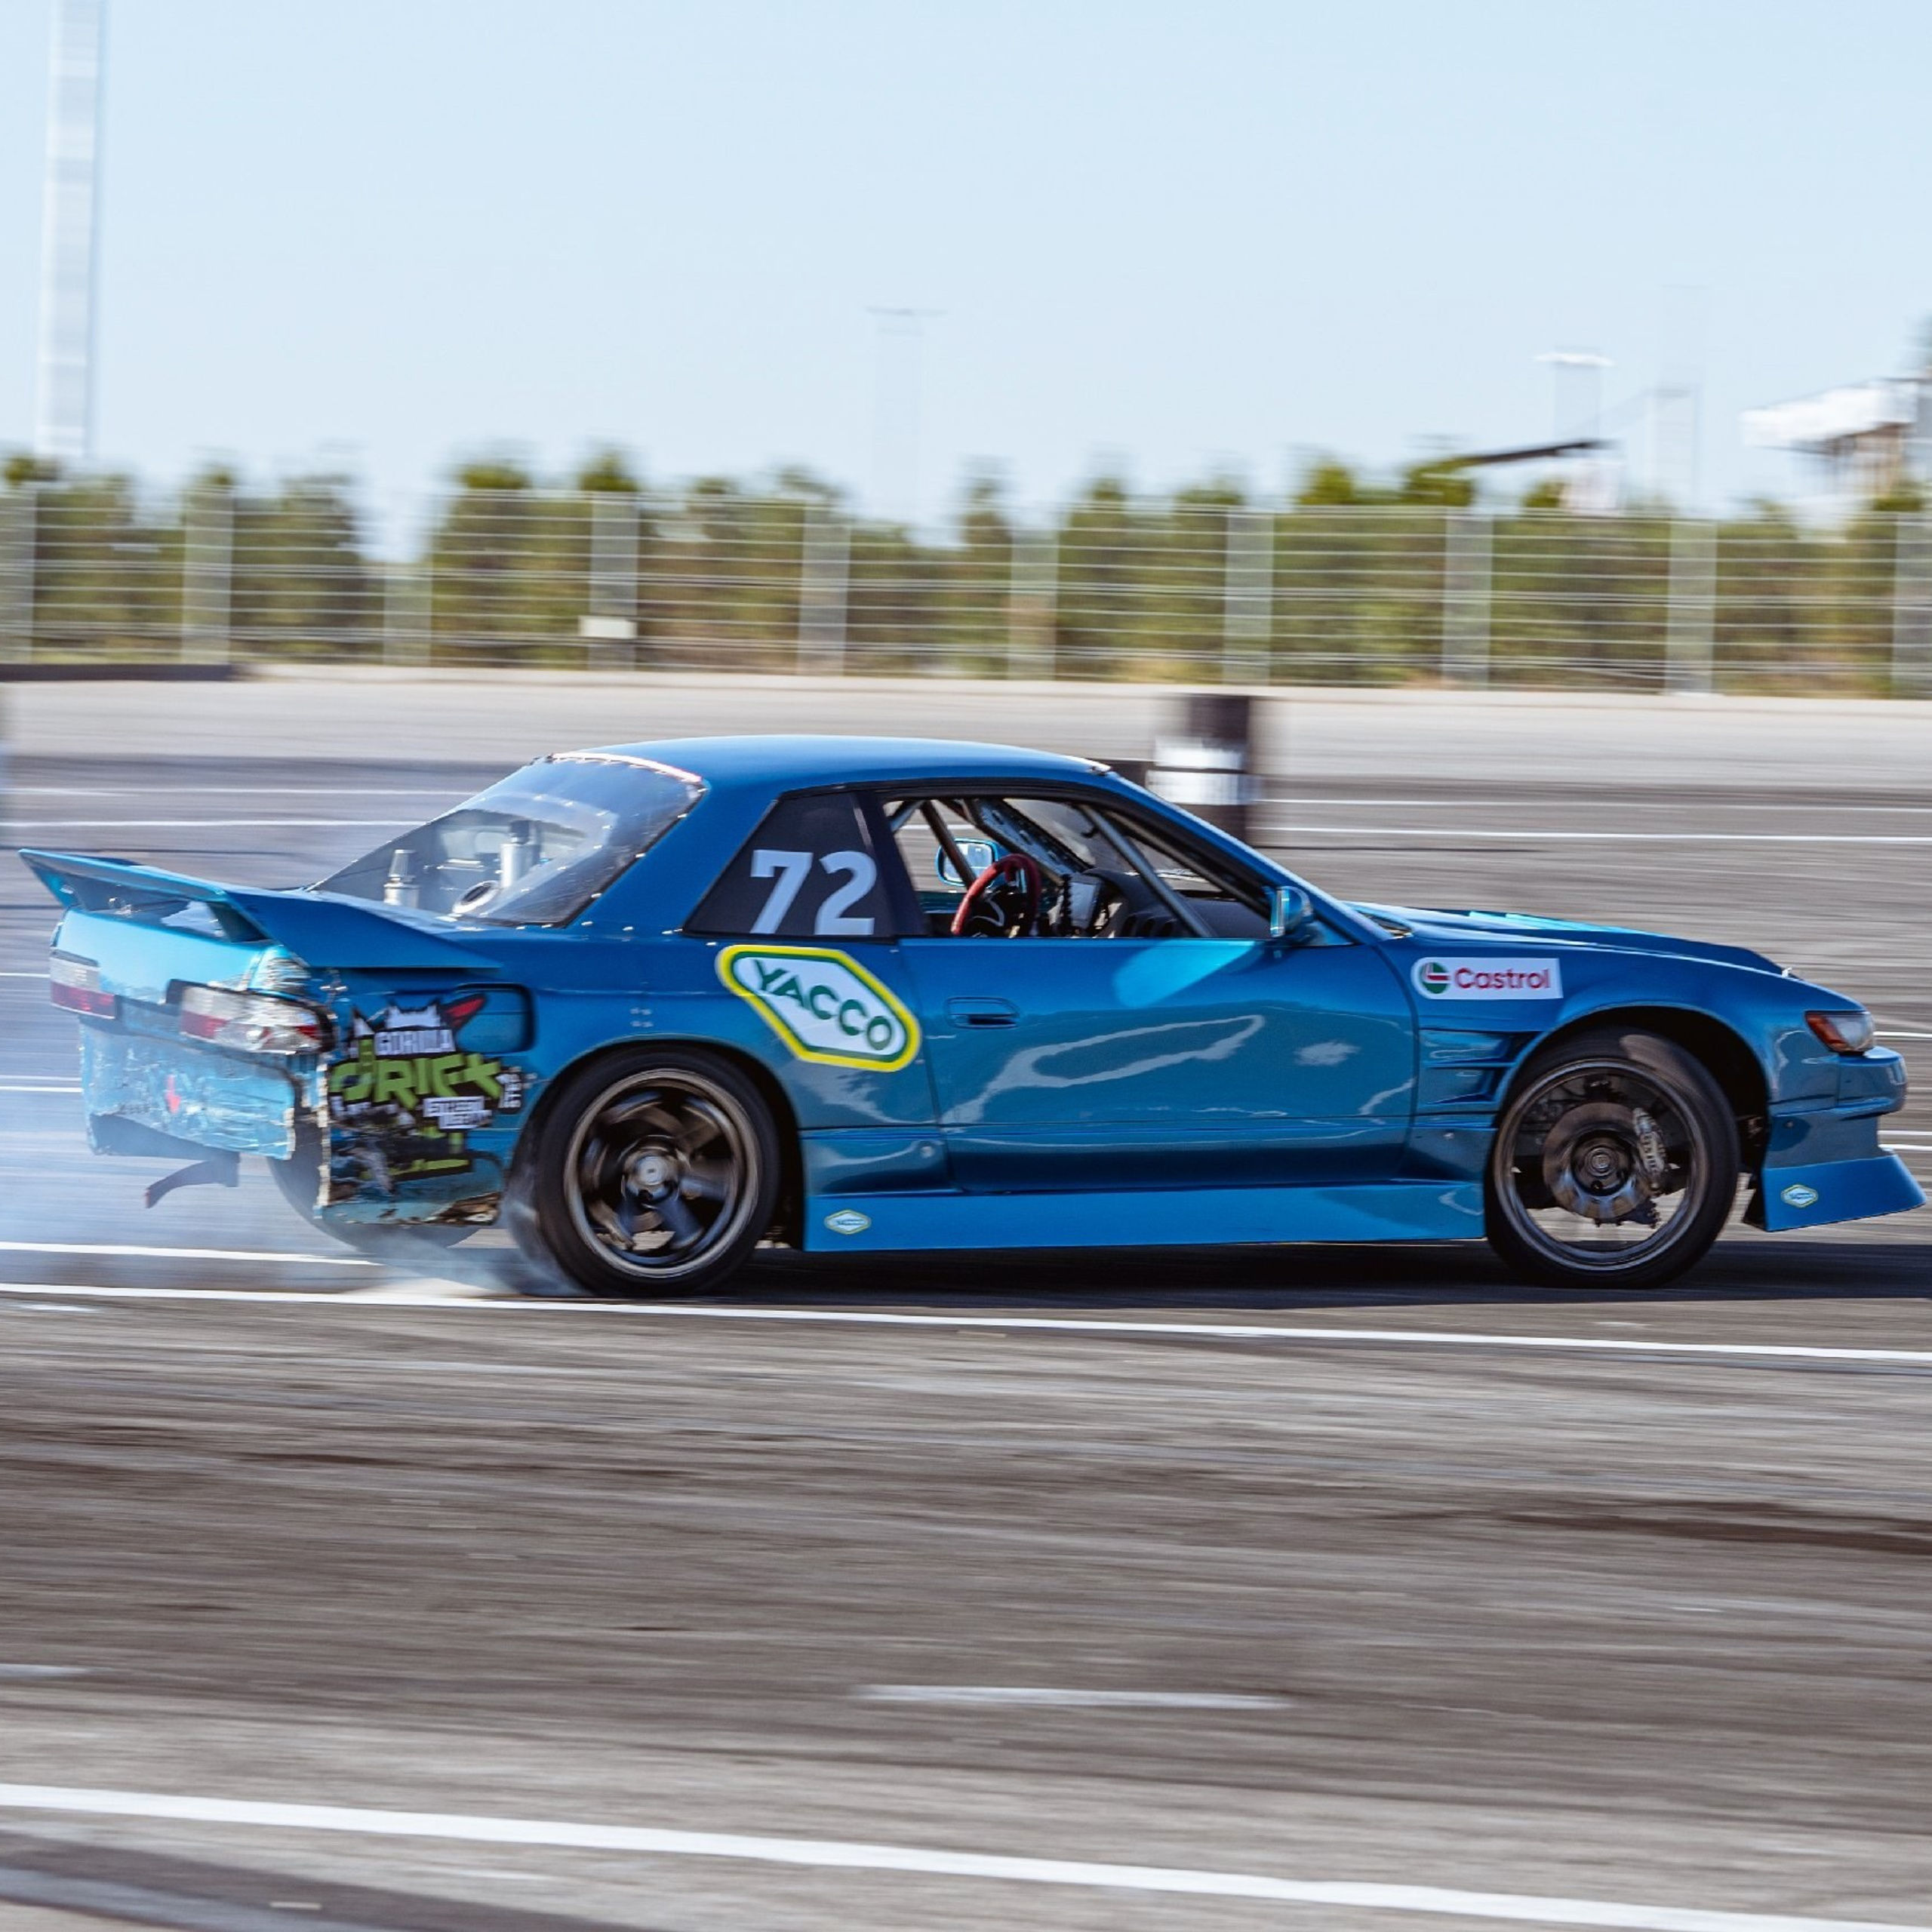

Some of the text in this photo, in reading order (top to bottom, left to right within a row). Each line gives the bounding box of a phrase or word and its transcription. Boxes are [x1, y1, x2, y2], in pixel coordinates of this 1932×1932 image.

[749, 849, 877, 935] 72
[752, 958, 893, 1051] YACCO
[1454, 967, 1552, 989] Castrol
